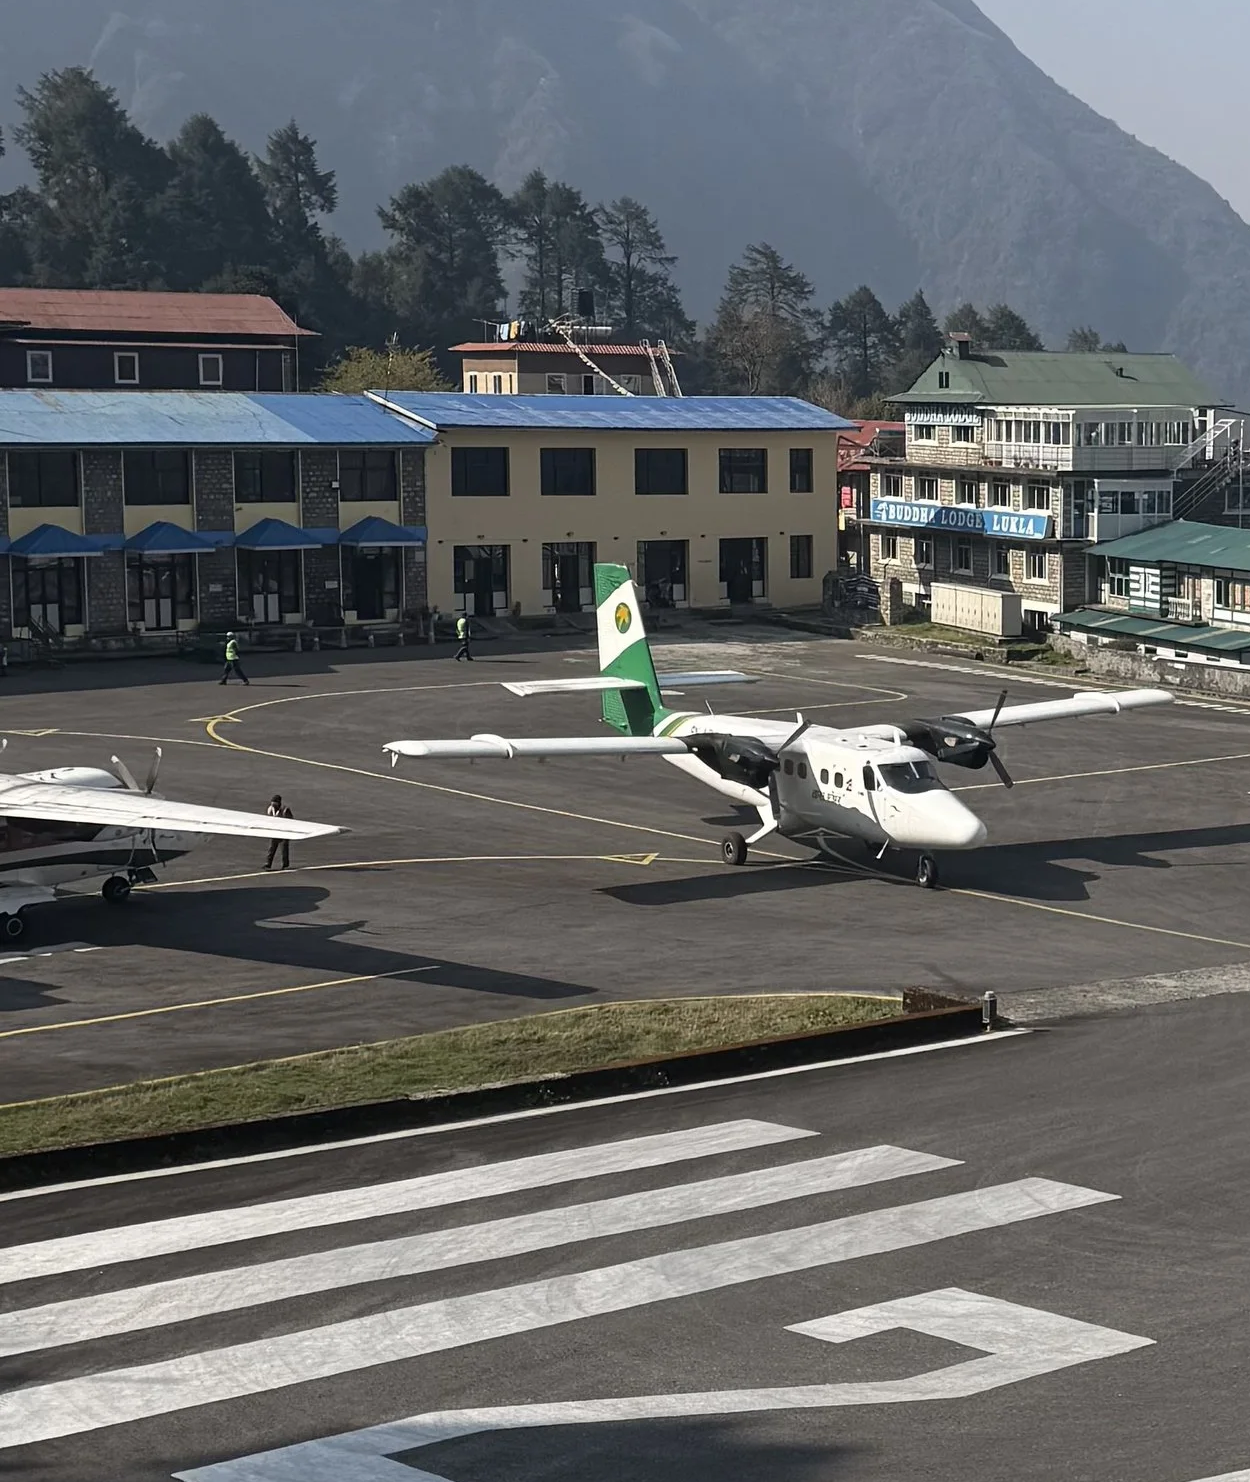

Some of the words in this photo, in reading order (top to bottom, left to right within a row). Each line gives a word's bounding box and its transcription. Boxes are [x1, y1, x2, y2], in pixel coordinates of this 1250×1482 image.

[888, 502, 936, 524] BUDDHA
[941, 509, 982, 529] LODGE
[992, 514, 1034, 535] LUKLA
